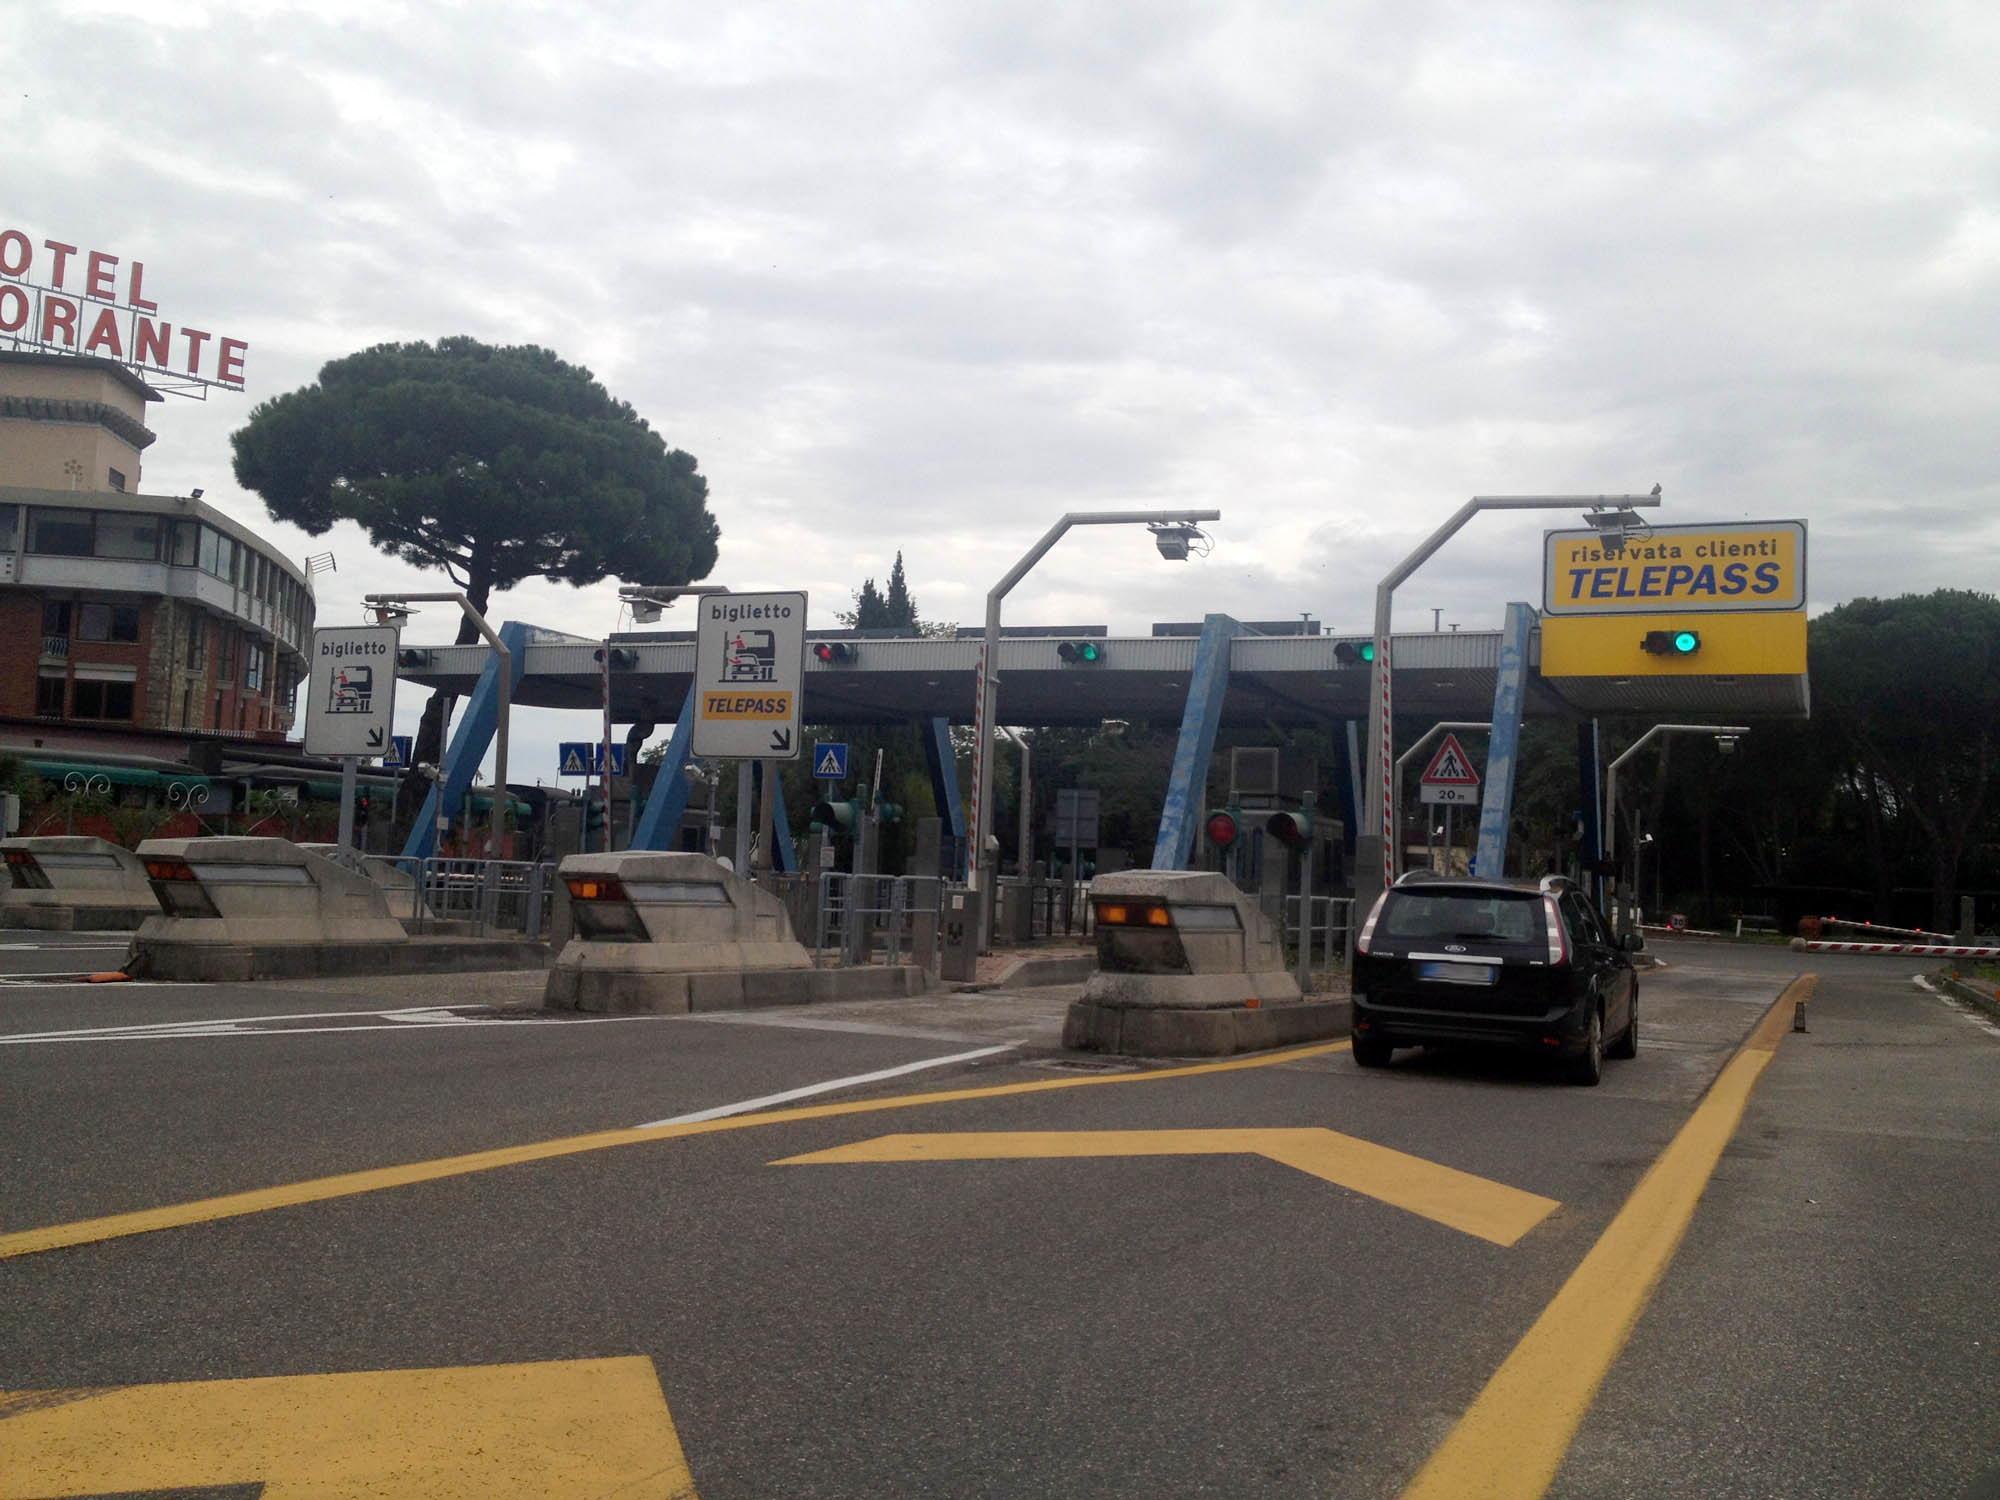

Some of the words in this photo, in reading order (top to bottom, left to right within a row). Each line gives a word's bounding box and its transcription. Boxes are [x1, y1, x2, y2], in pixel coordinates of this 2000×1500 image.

[0, 230, 158, 311] OTEL
[0, 285, 248, 385] ORANTE
[1571, 542, 1682, 562] riservata
[1695, 539, 1777, 557] clienti
[1568, 562, 1781, 599] TELEPASS
[712, 604, 791, 622] biglietto
[321, 642, 386, 657] biglietto
[707, 698, 787, 713] TELEPASS
[1439, 790, 1455, 800] 20
